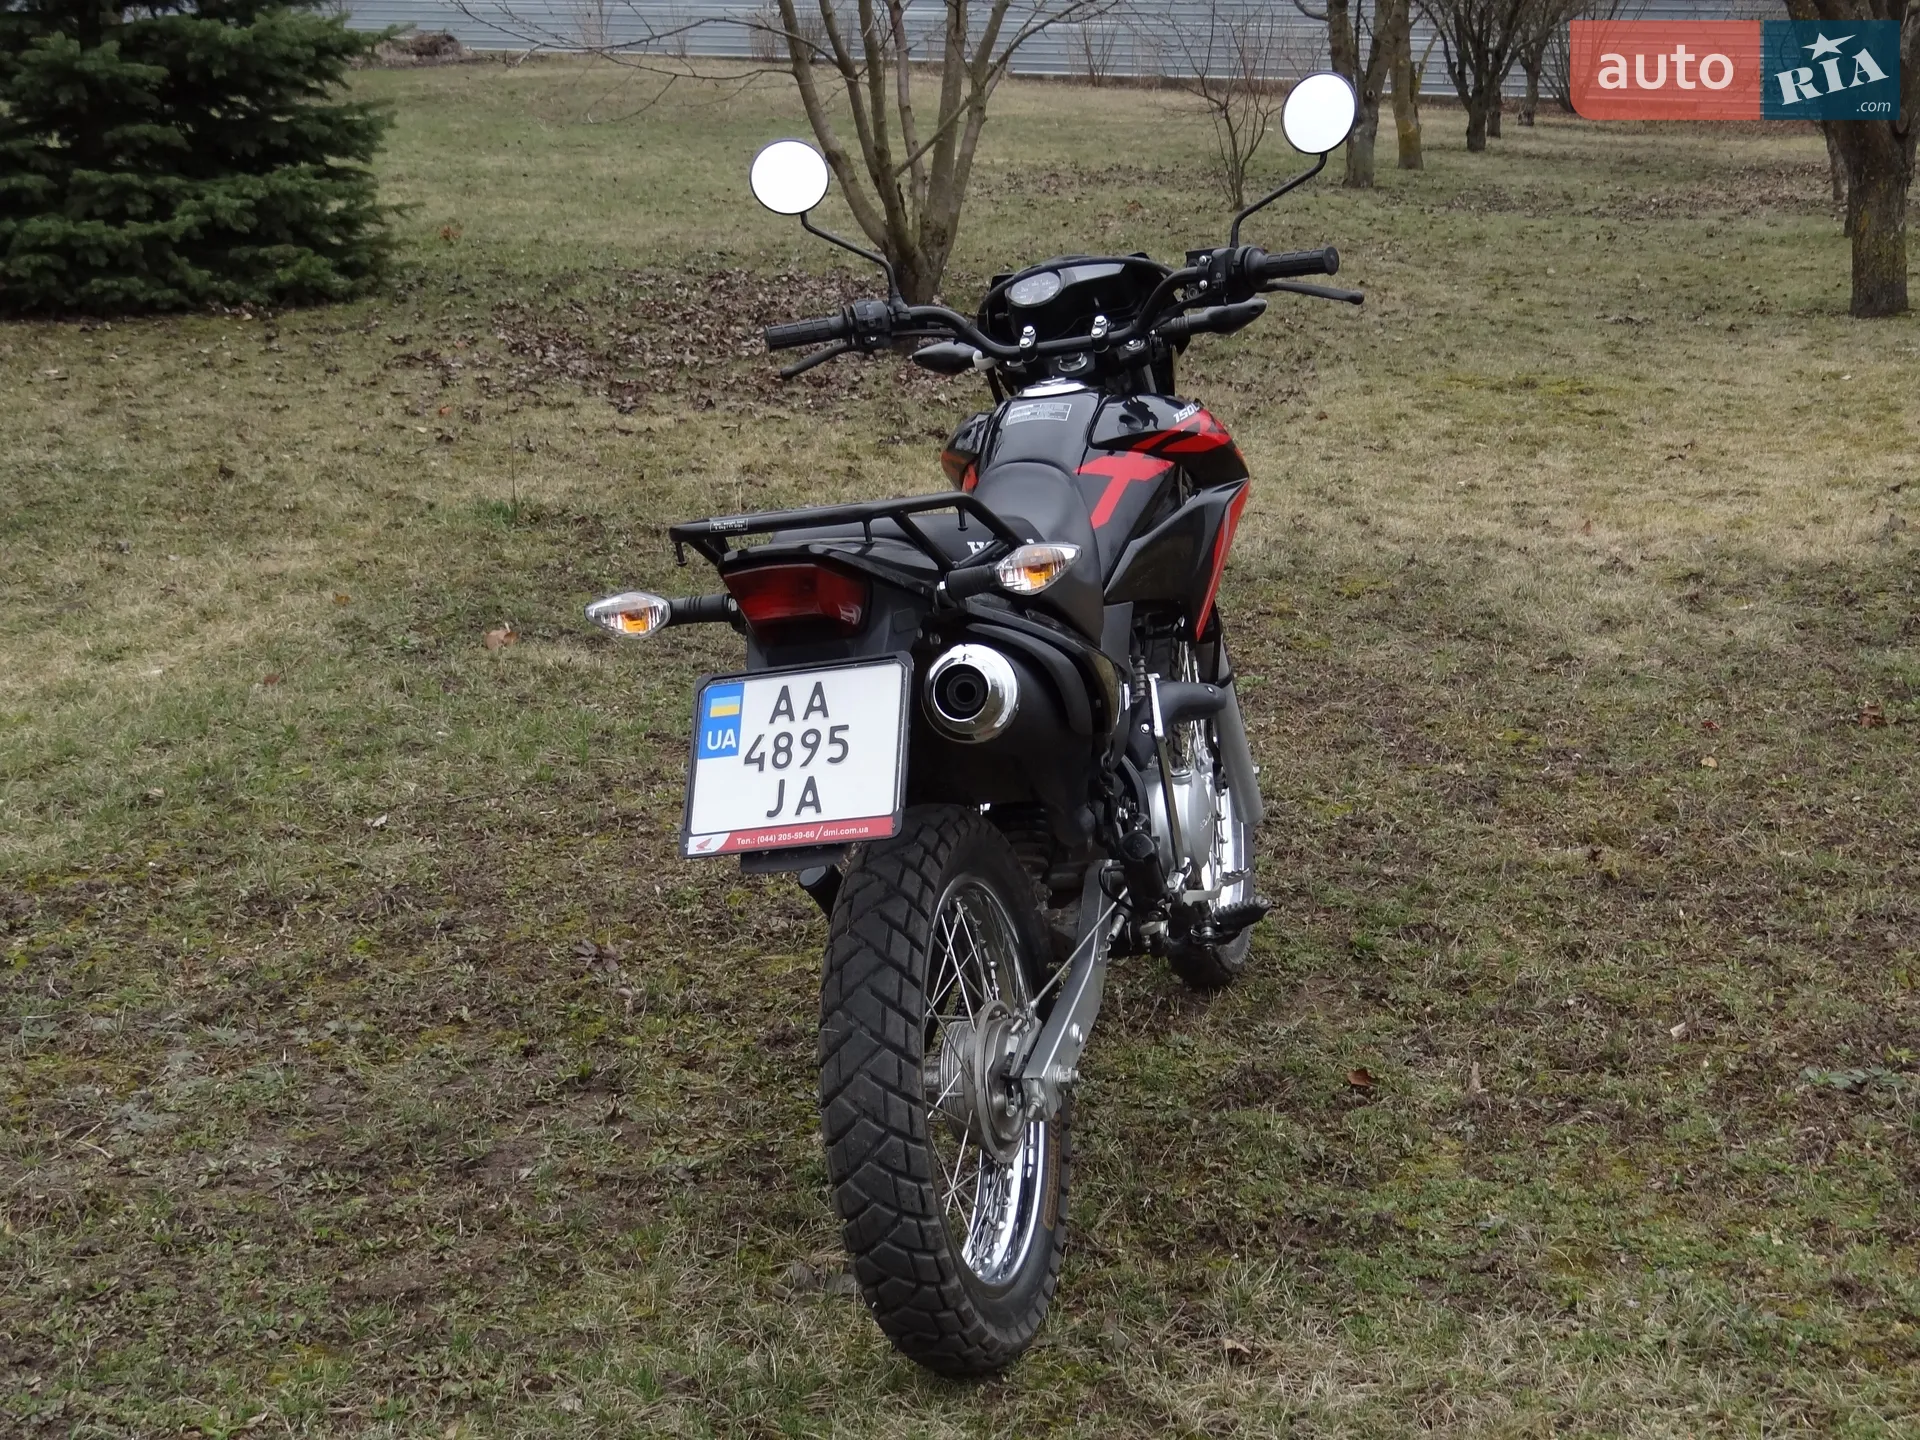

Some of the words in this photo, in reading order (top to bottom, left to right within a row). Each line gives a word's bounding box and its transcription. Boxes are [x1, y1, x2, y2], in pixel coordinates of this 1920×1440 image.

[768, 680, 830, 725] AA
[706, 728, 737, 751] UA
[743, 724, 850, 773] 4895
[766, 775, 822, 819] JA
[757, 835, 776, 845] (044)
